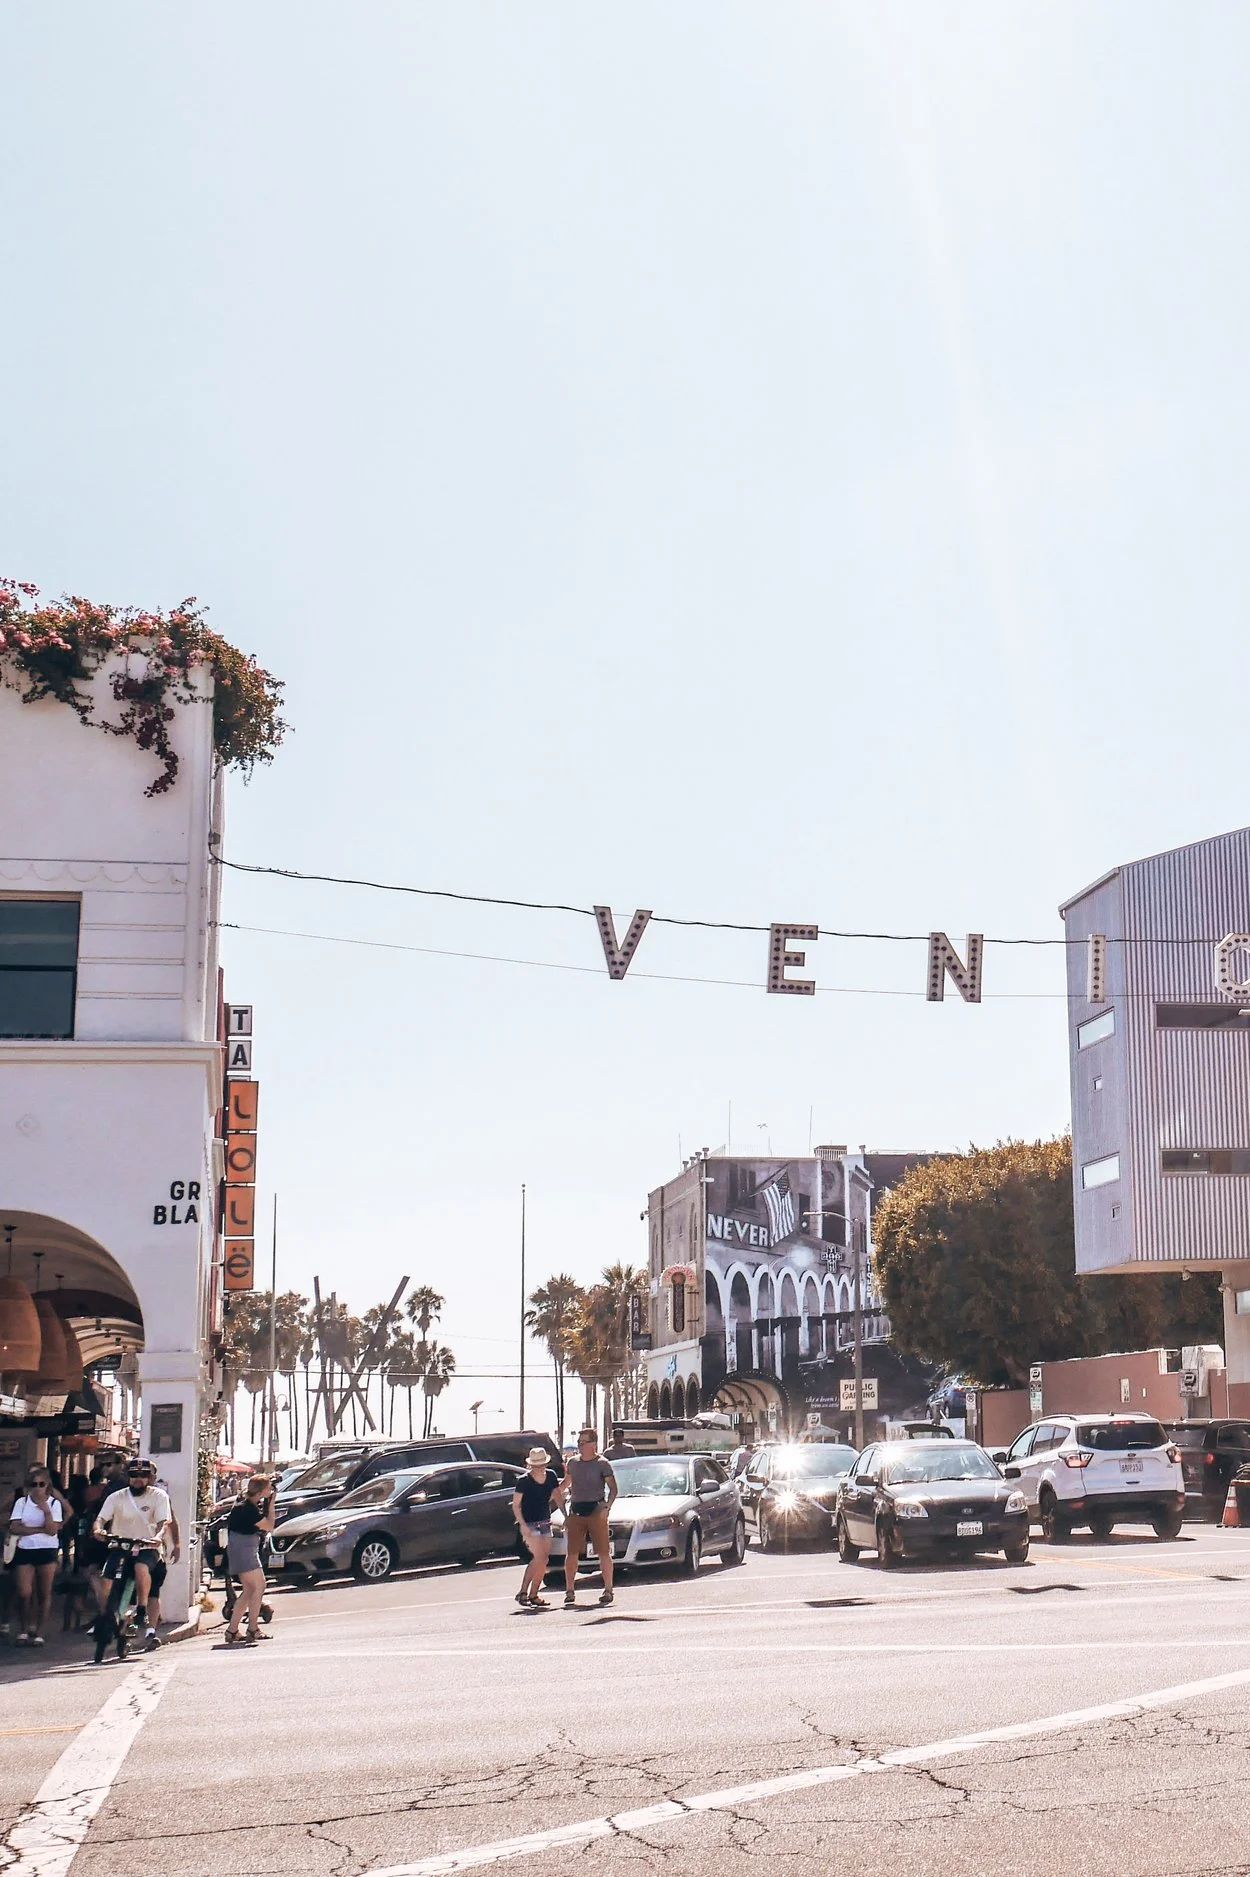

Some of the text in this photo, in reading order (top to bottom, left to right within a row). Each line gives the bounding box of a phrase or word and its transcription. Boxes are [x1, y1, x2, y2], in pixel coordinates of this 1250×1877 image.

[231, 1009, 249, 1081] TA
[706, 1213, 770, 1248] NEVER
[842, 1391, 876, 1400] PAING
[844, 1383, 873, 1391] PUIC
